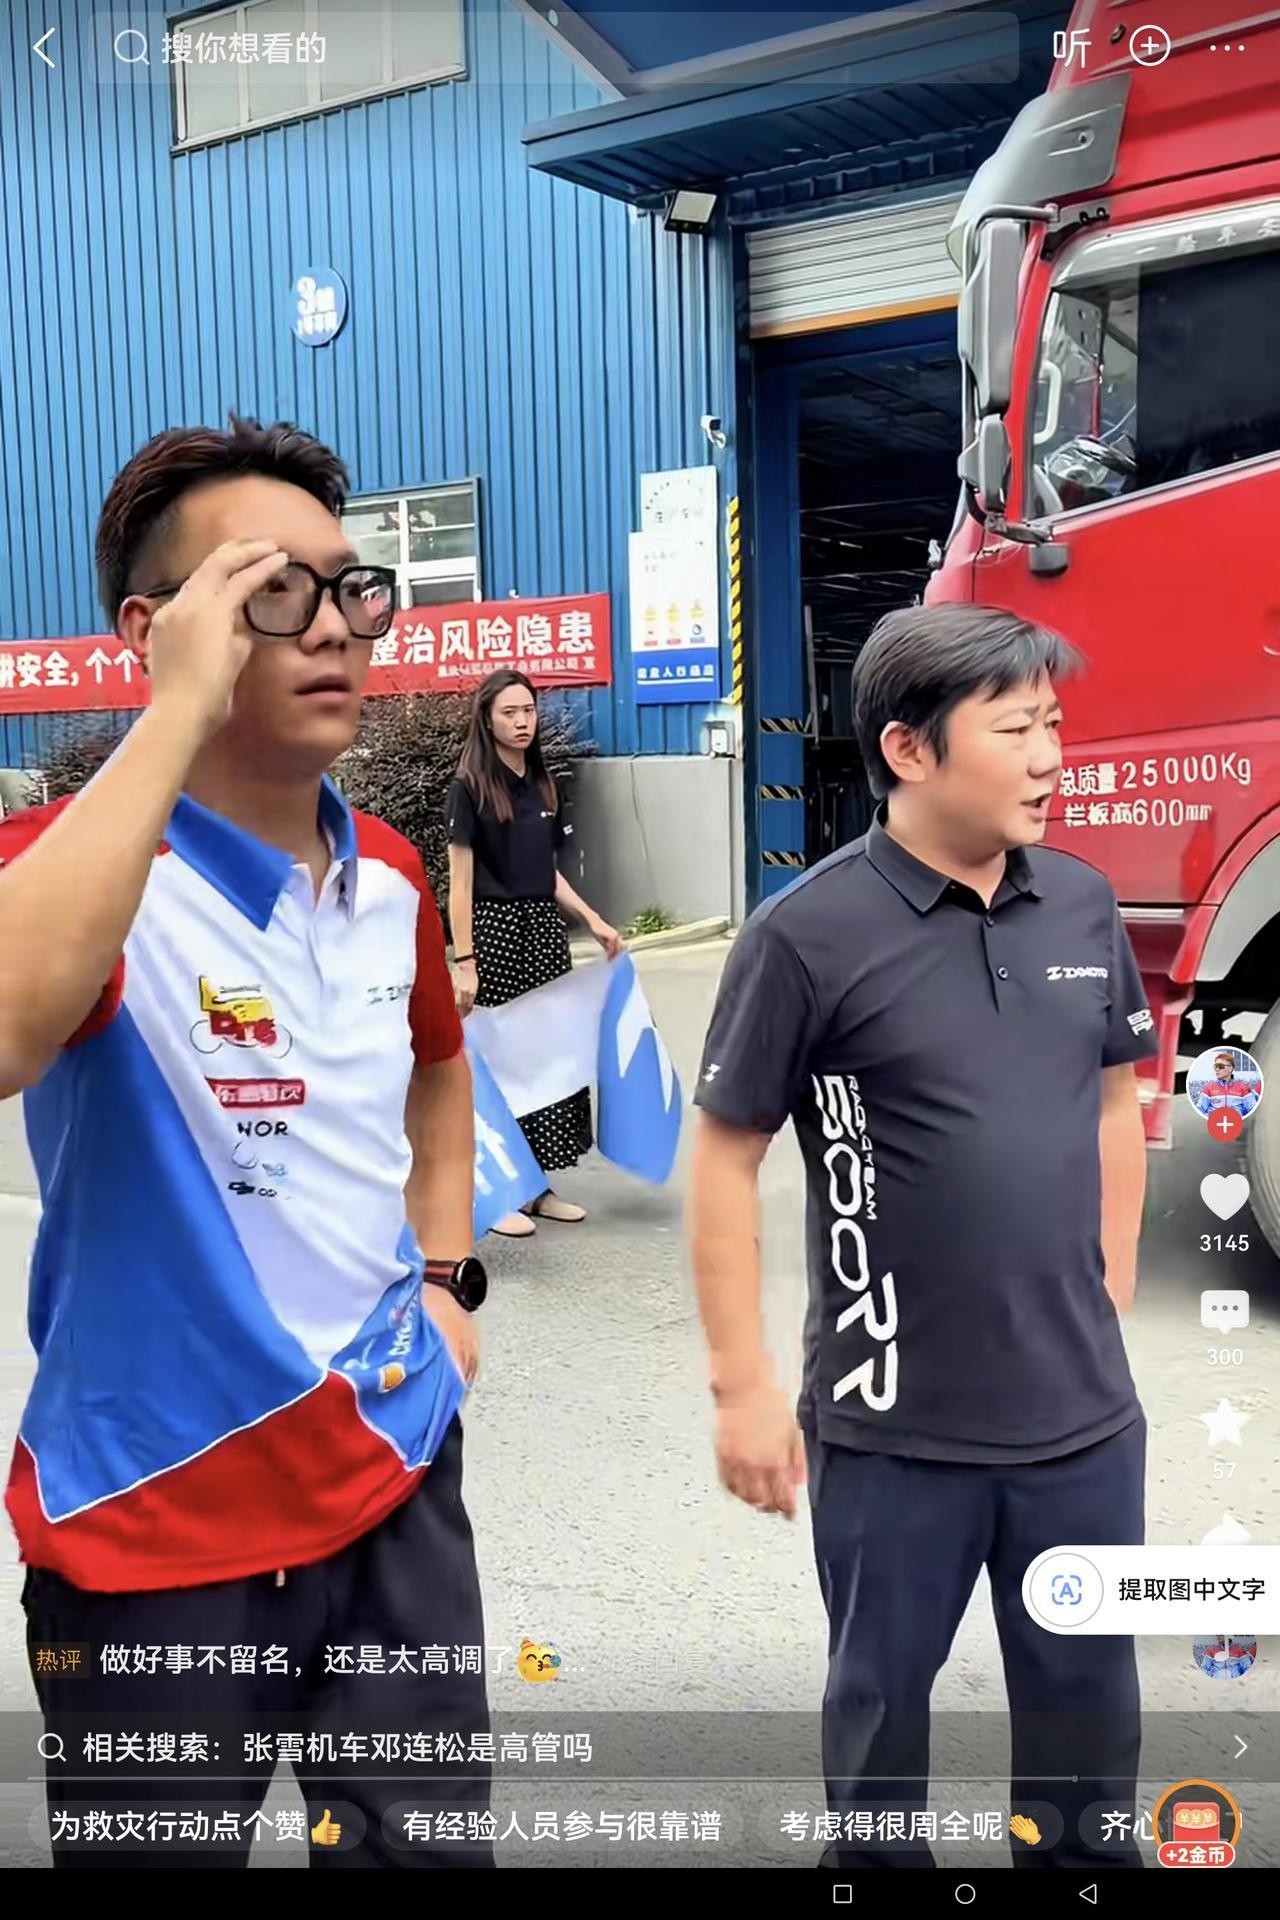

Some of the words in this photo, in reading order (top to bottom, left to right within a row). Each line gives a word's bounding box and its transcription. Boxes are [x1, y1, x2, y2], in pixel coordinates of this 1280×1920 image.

[369, 609, 596, 667] 整治风险隐患
